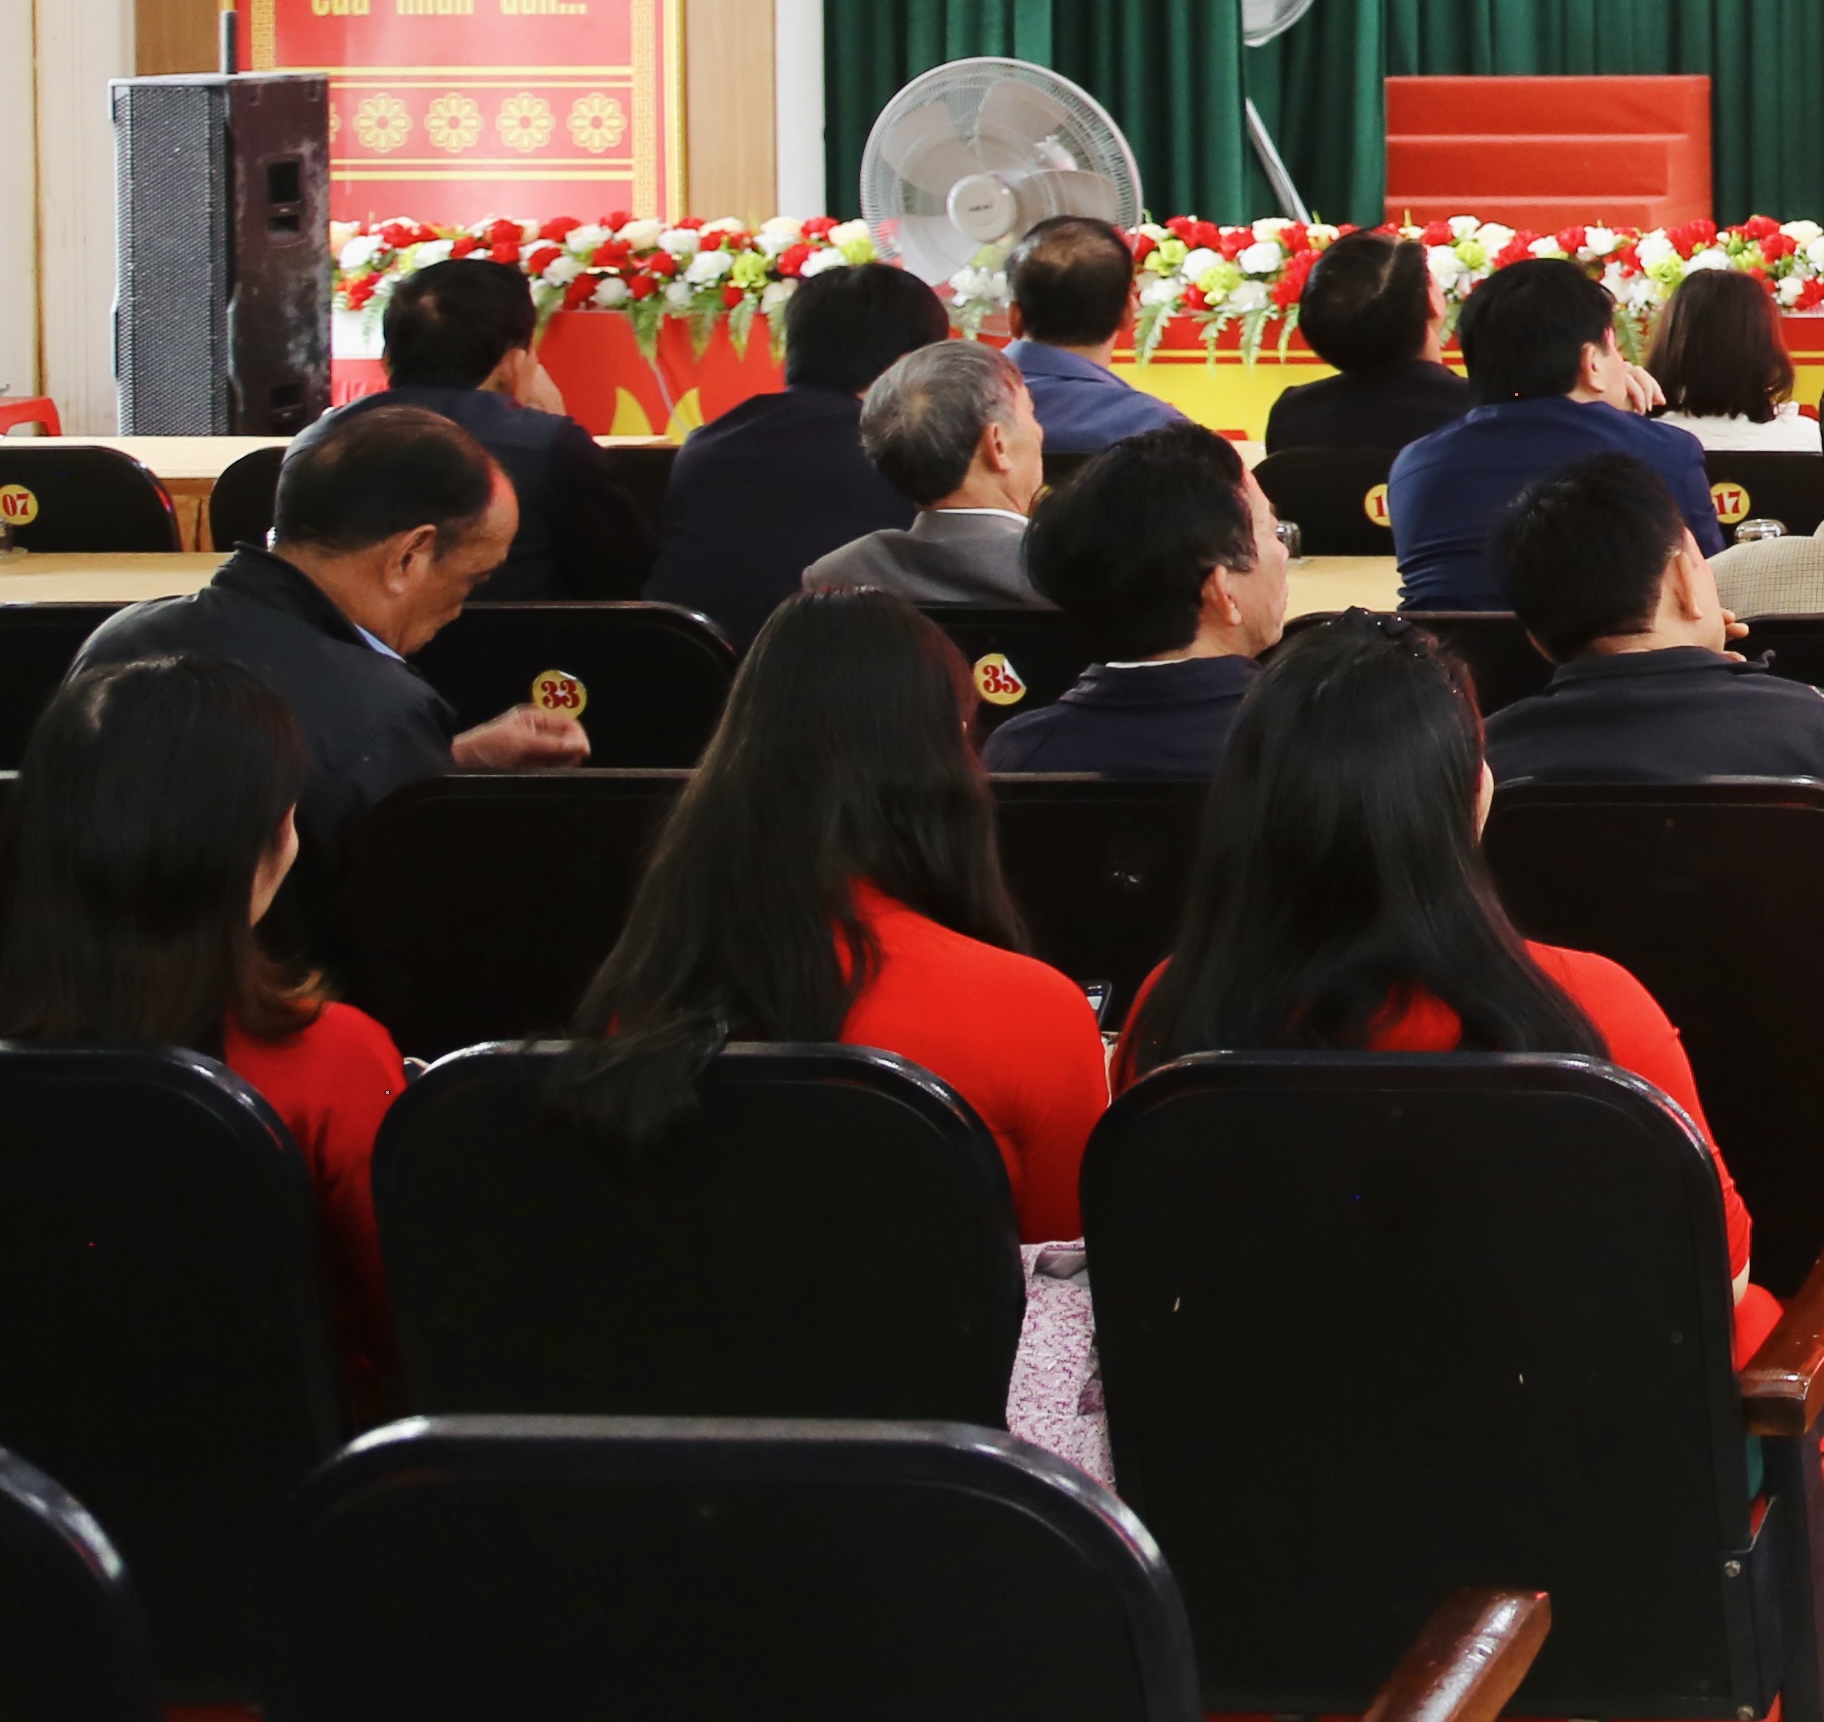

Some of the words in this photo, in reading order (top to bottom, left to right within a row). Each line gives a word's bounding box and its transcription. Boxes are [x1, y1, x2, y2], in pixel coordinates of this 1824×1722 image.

[2, 493, 30, 517] 07
[1713, 491, 1742, 515] 17
[541, 679, 581, 710] 33
